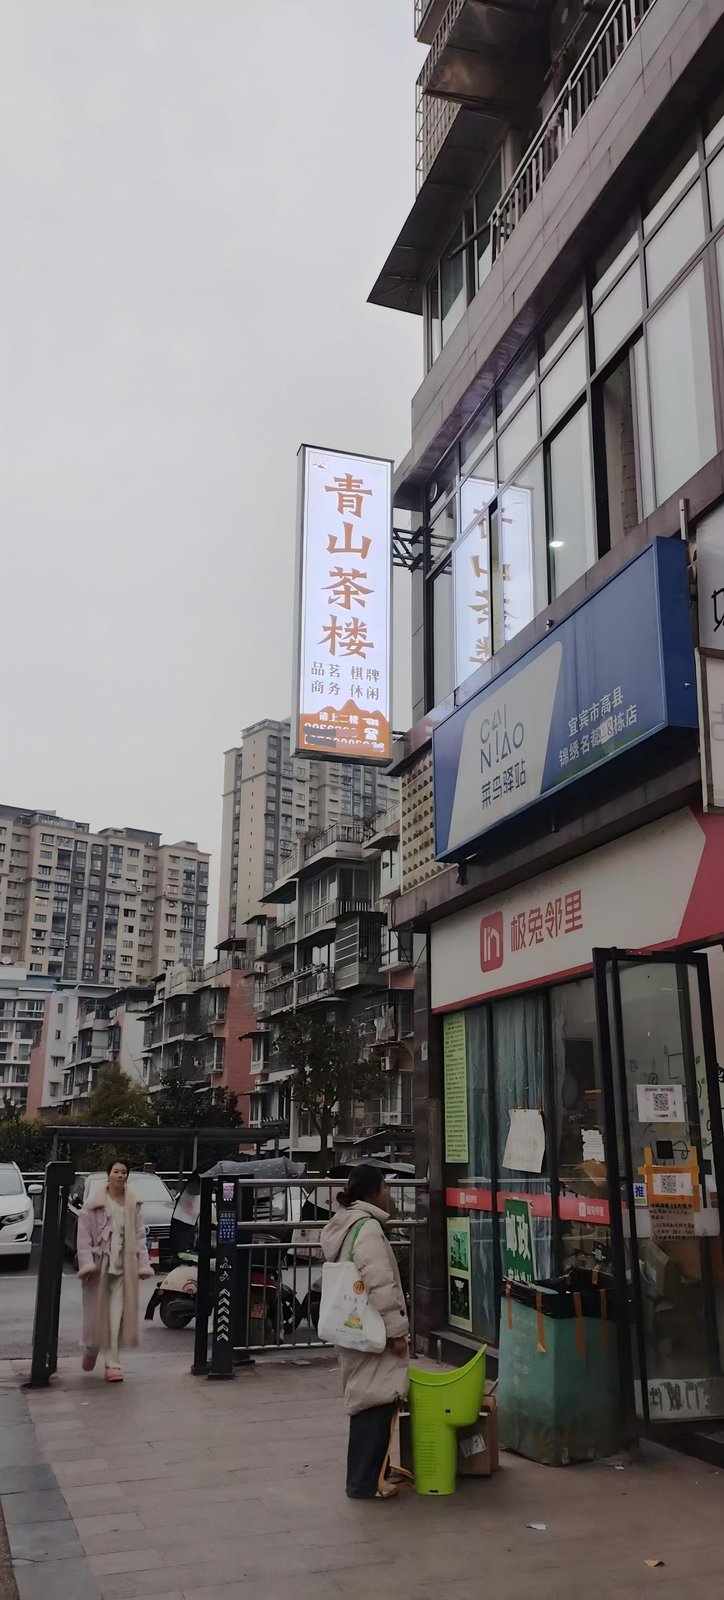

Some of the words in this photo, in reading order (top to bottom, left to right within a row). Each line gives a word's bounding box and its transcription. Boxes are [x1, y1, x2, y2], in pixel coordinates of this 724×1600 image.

[317, 472, 375, 659] 青山茶楼
[311, 661, 341, 678] 品茗
[351, 666, 380, 682] 棋牌
[311, 679, 341, 696] 商务
[350, 684, 379, 700] 休闲
[319, 711, 359, 725] 请上二楼
[480, 703, 507, 744] CAI
[568, 685, 624, 738] 宜宾市高县
[481, 758, 527, 809] 菜鸟驿站
[510, 889, 584, 953] 极兔邻里
[634, 1184, 645, 1198] 推
